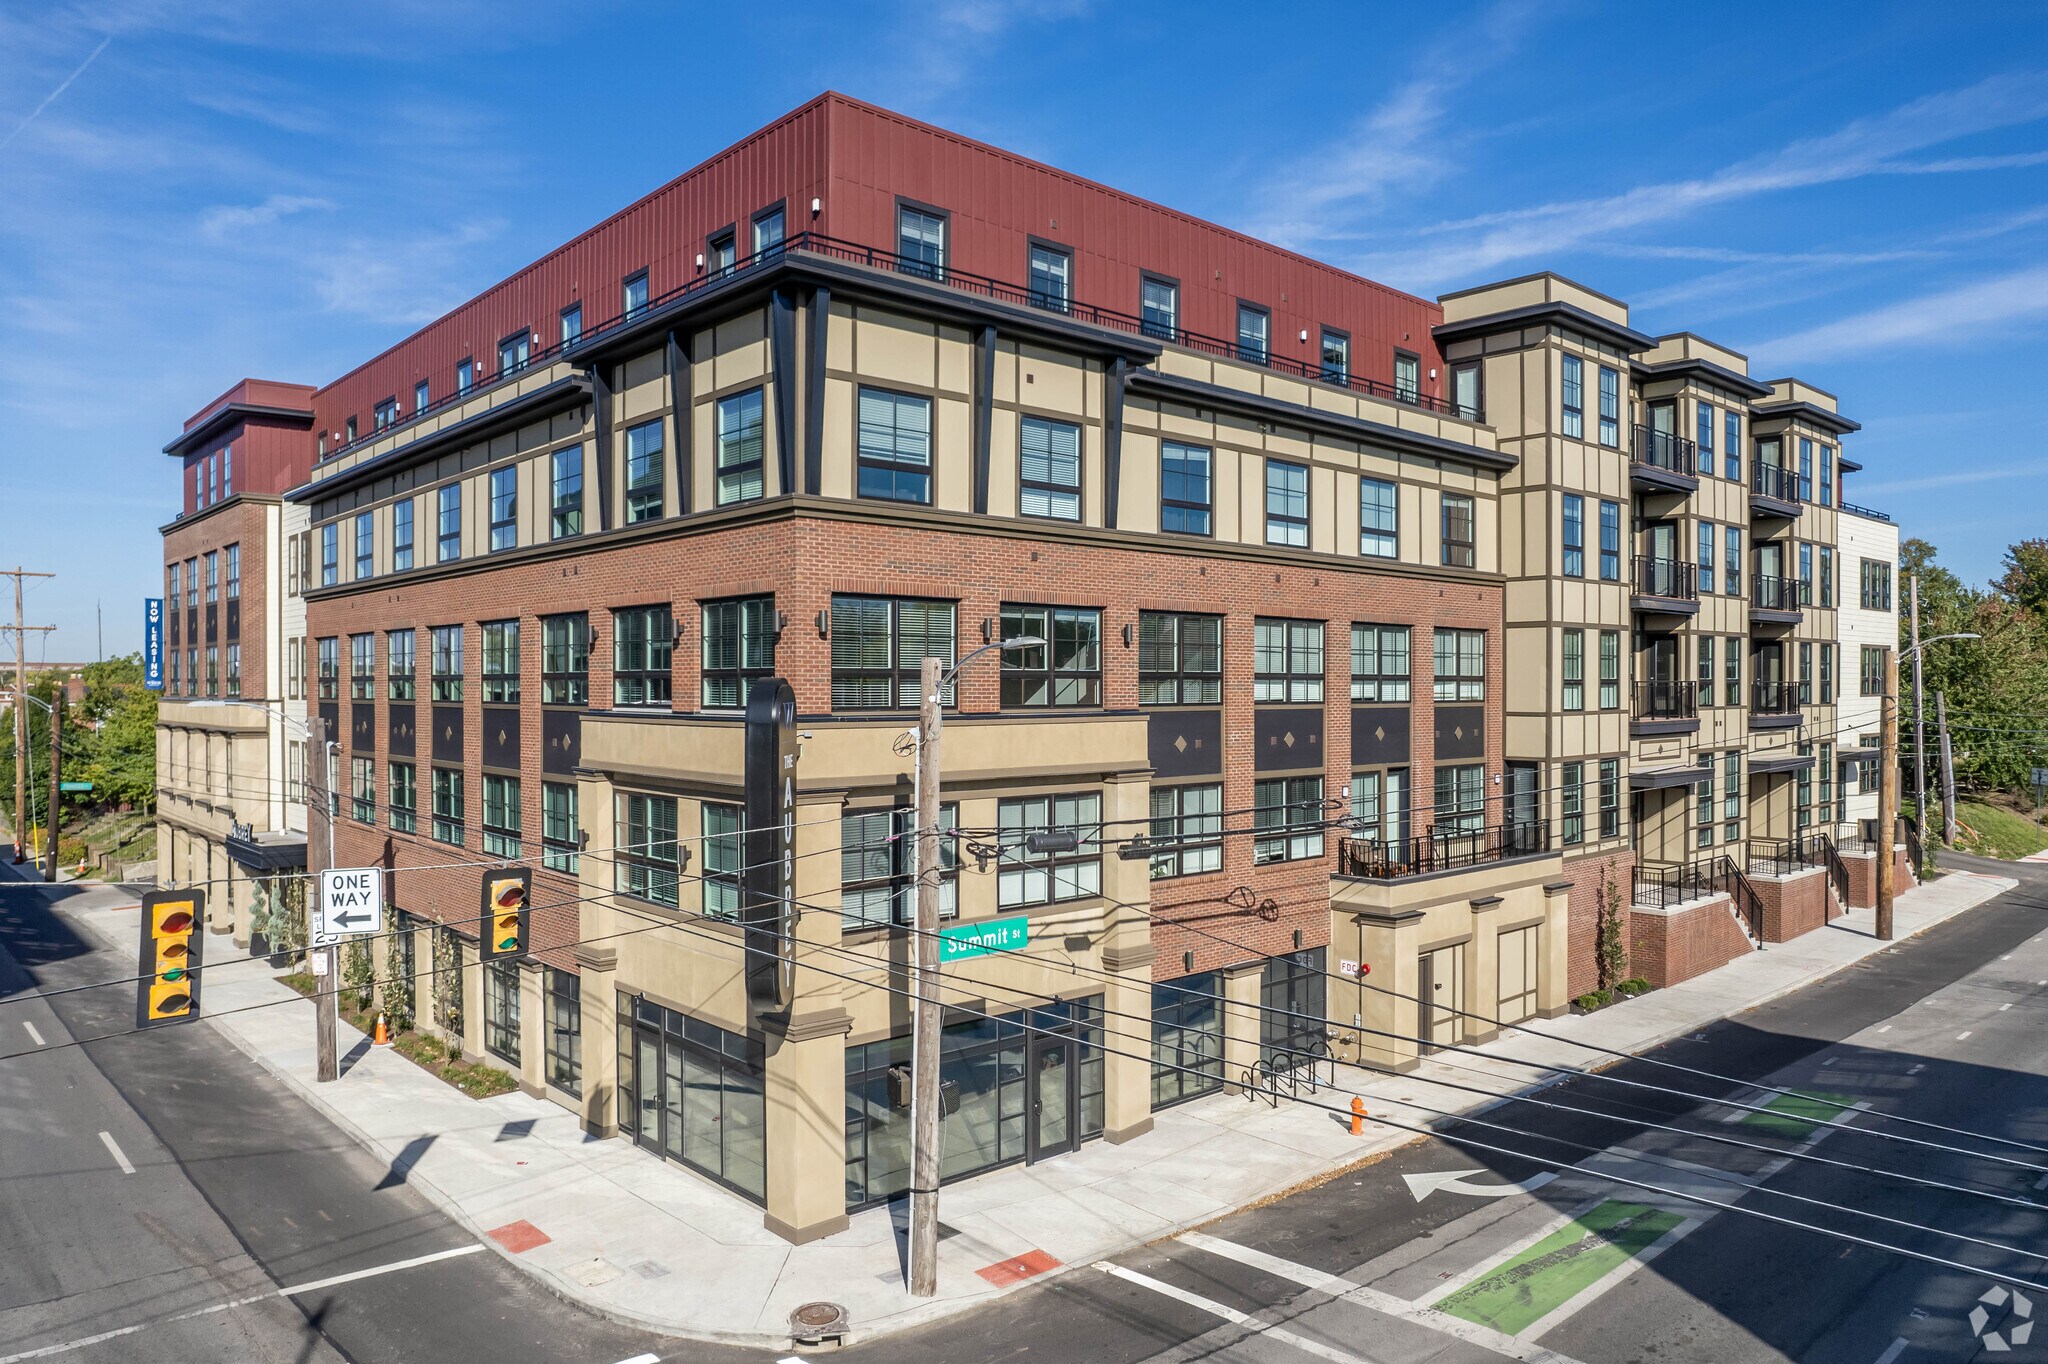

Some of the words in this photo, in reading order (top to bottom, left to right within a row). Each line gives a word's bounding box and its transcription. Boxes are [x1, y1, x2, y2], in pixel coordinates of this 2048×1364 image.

[149, 601, 159, 623] NOW
[150, 626, 159, 678] LEASING
[784, 754, 793, 769] THE
[333, 874, 370, 890] ONE
[784, 776, 793, 988] AUBREY
[331, 891, 371, 907] WAY
[948, 928, 1008, 953] Summit
[1012, 929, 1021, 939] St
[1342, 962, 1357, 972] FDC
